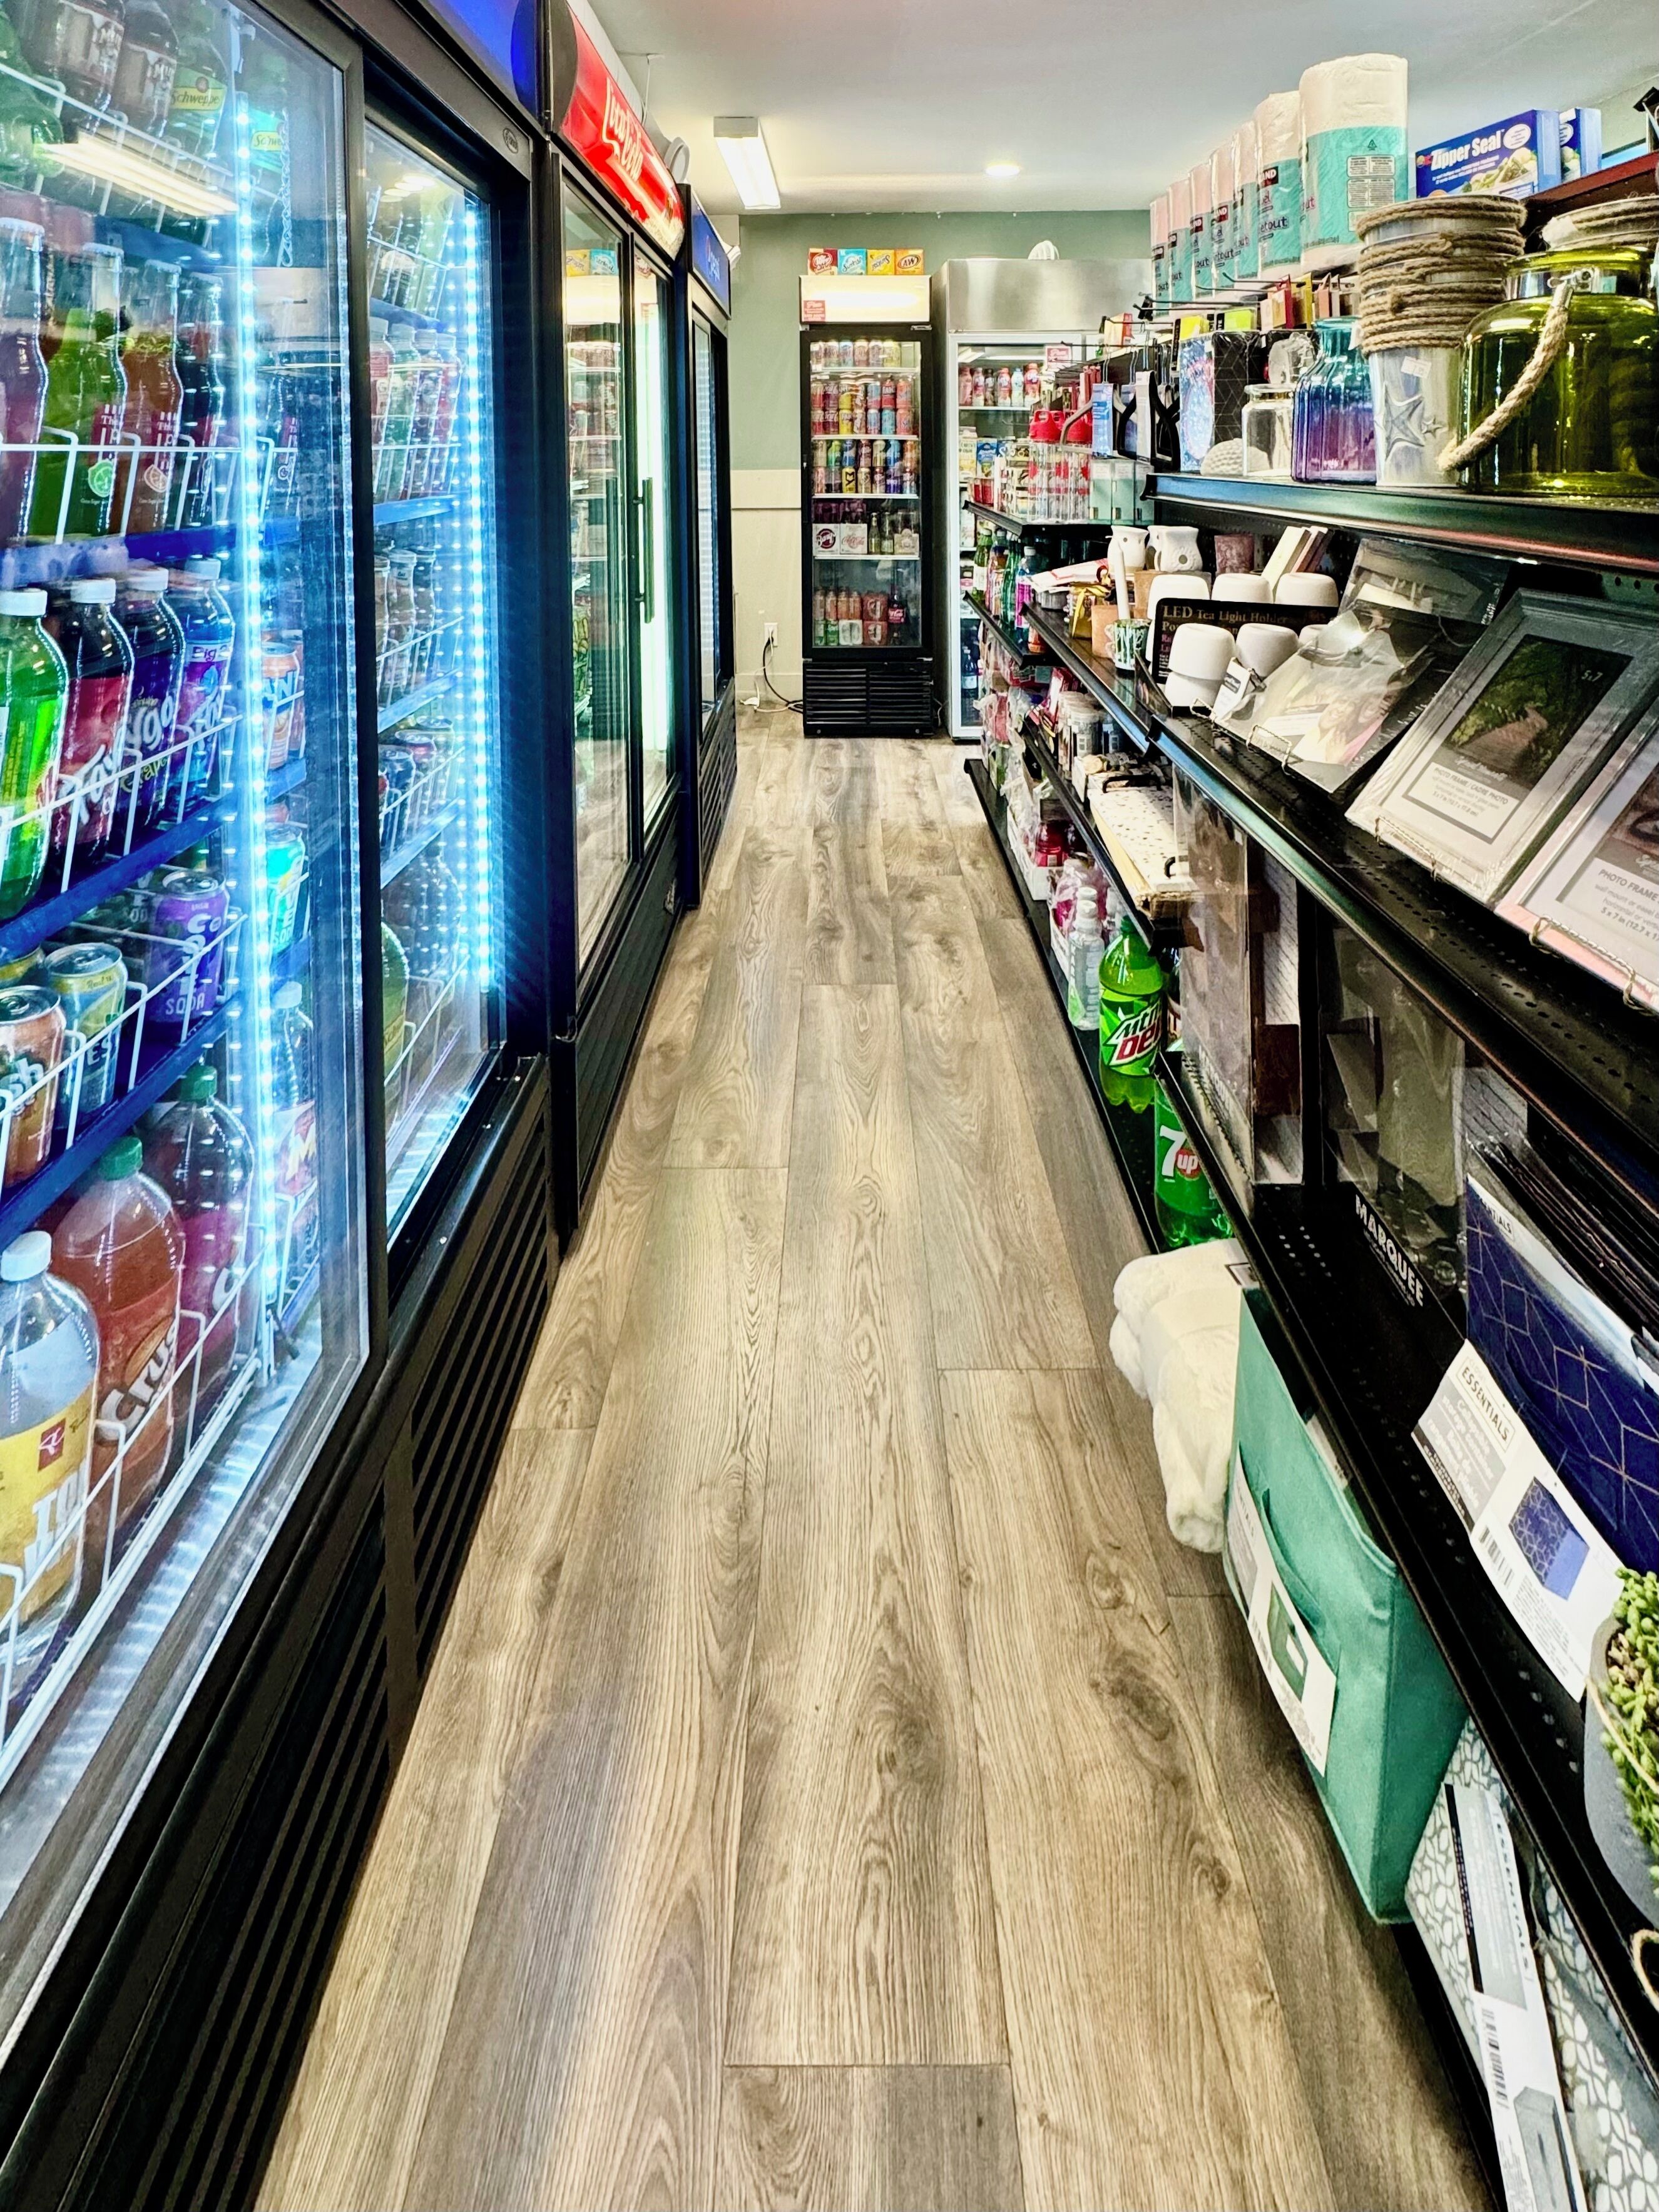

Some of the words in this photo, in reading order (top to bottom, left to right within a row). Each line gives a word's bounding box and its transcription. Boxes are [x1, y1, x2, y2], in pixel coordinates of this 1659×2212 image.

[1431, 143, 1471, 171] Zipper
[1471, 131, 1502, 156] Seal
[1162, 605, 1193, 619] LED
[1196, 609, 1215, 620] Tea
[1219, 611, 1247, 623] Light
[1434, 767, 1451, 778] PHOTO
[1450, 775, 1468, 787] FRAME
[1471, 783, 1489, 796] CADRE
[1489, 792, 1508, 805] PHOTO
[1598, 869, 1627, 886] PHOTO
[1628, 882, 1658, 901] FRAME
[1177, 1153, 1198, 1175] up
[1355, 1193, 1424, 1307] MARQUEE
[1462, 1366, 1509, 1441] ESSENTIALS
[1496, 1823, 1529, 1970] ESSENTIALS
